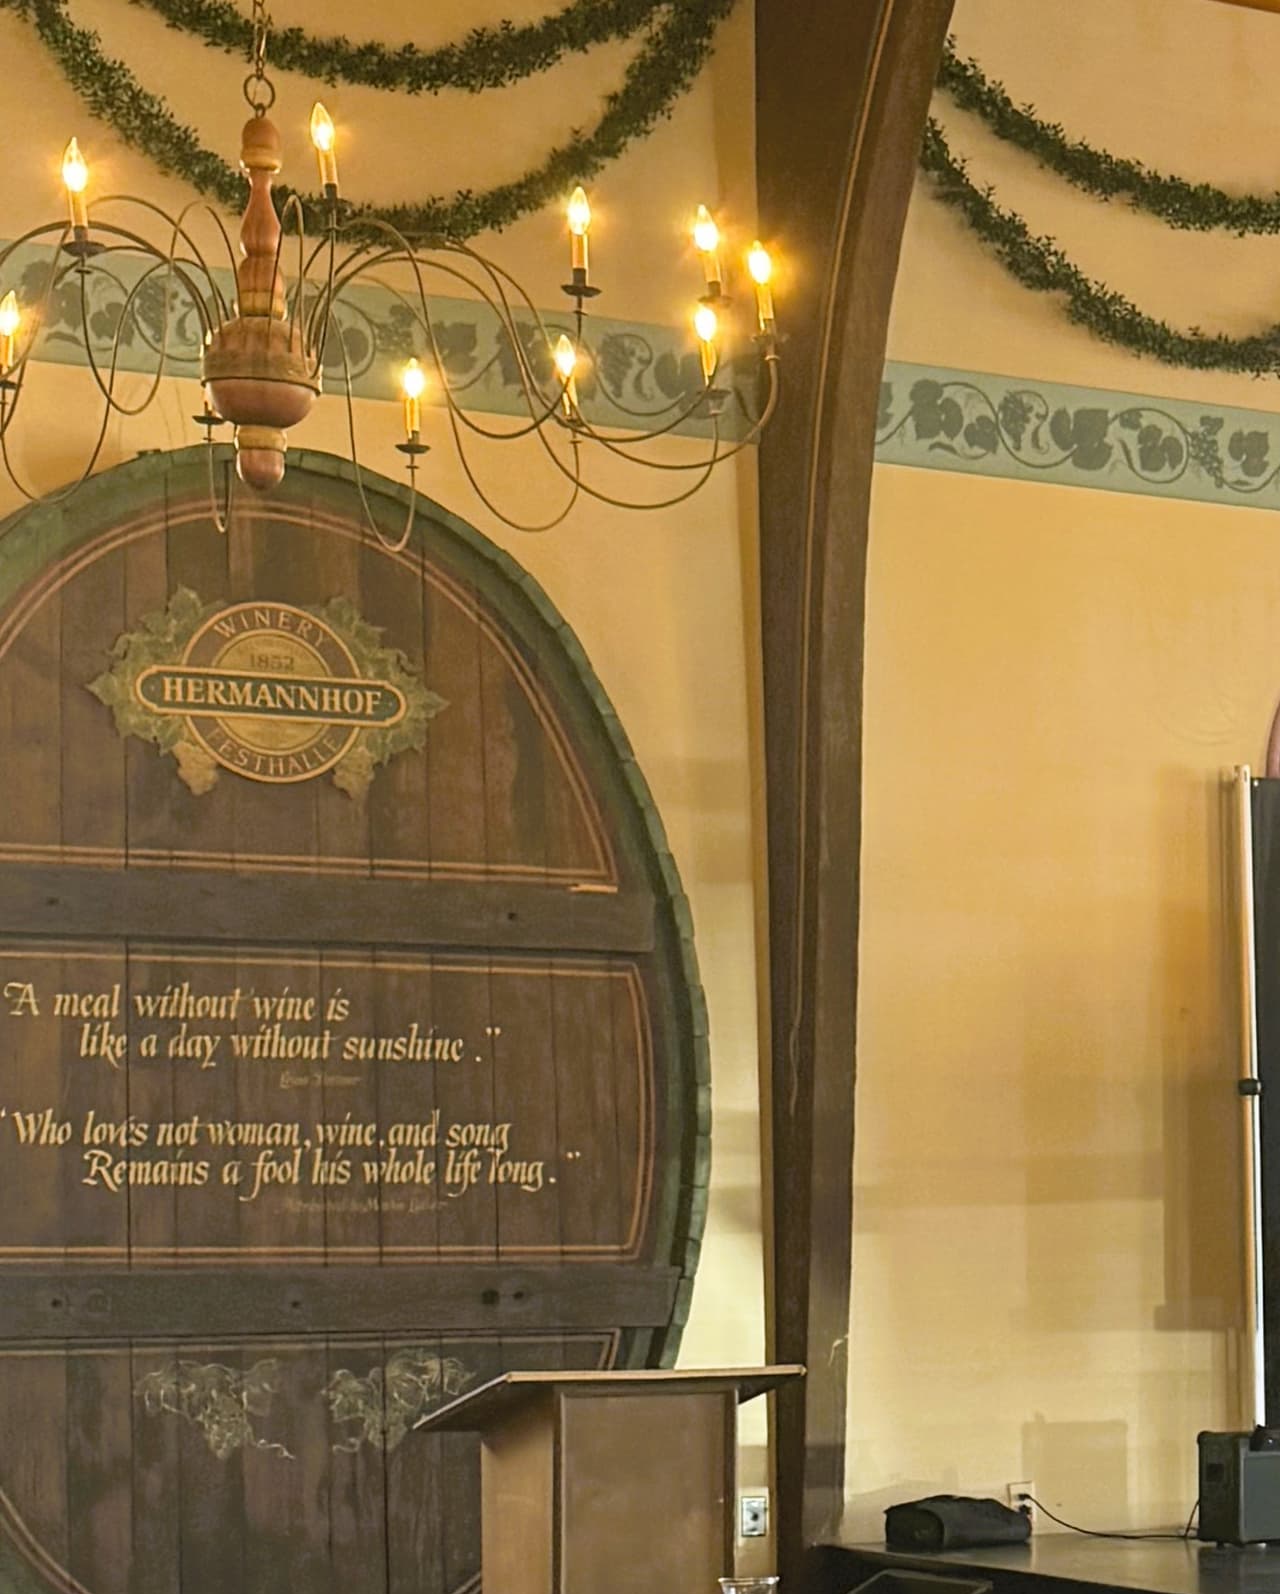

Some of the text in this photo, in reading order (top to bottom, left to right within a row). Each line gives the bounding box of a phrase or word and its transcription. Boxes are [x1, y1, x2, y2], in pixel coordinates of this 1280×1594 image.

[213, 608, 327, 647] WINERY
[163, 676, 381, 715] HERMANNHOF
[207, 727, 341, 776] FESTHALLE
[54, 983, 120, 1018] meal
[134, 981, 242, 1020] without
[252, 986, 315, 1021] wine
[326, 987, 349, 1021] is
[80, 1021, 127, 1069] like
[141, 1032, 157, 1057] a
[168, 1023, 221, 1069] day
[231, 1023, 332, 1060] without
[83, 1110, 148, 1147] loves
[156, 1115, 200, 1146] not
[389, 1109, 440, 1147] and
[445, 1122, 512, 1151] song
[82, 1150, 209, 1192] Remains
[222, 1160, 241, 1185] a
[239, 1148, 302, 1201] fool
[312, 1148, 350, 1185] his
[363, 1149, 436, 1185] whole
[446, 1149, 482, 1197] life
